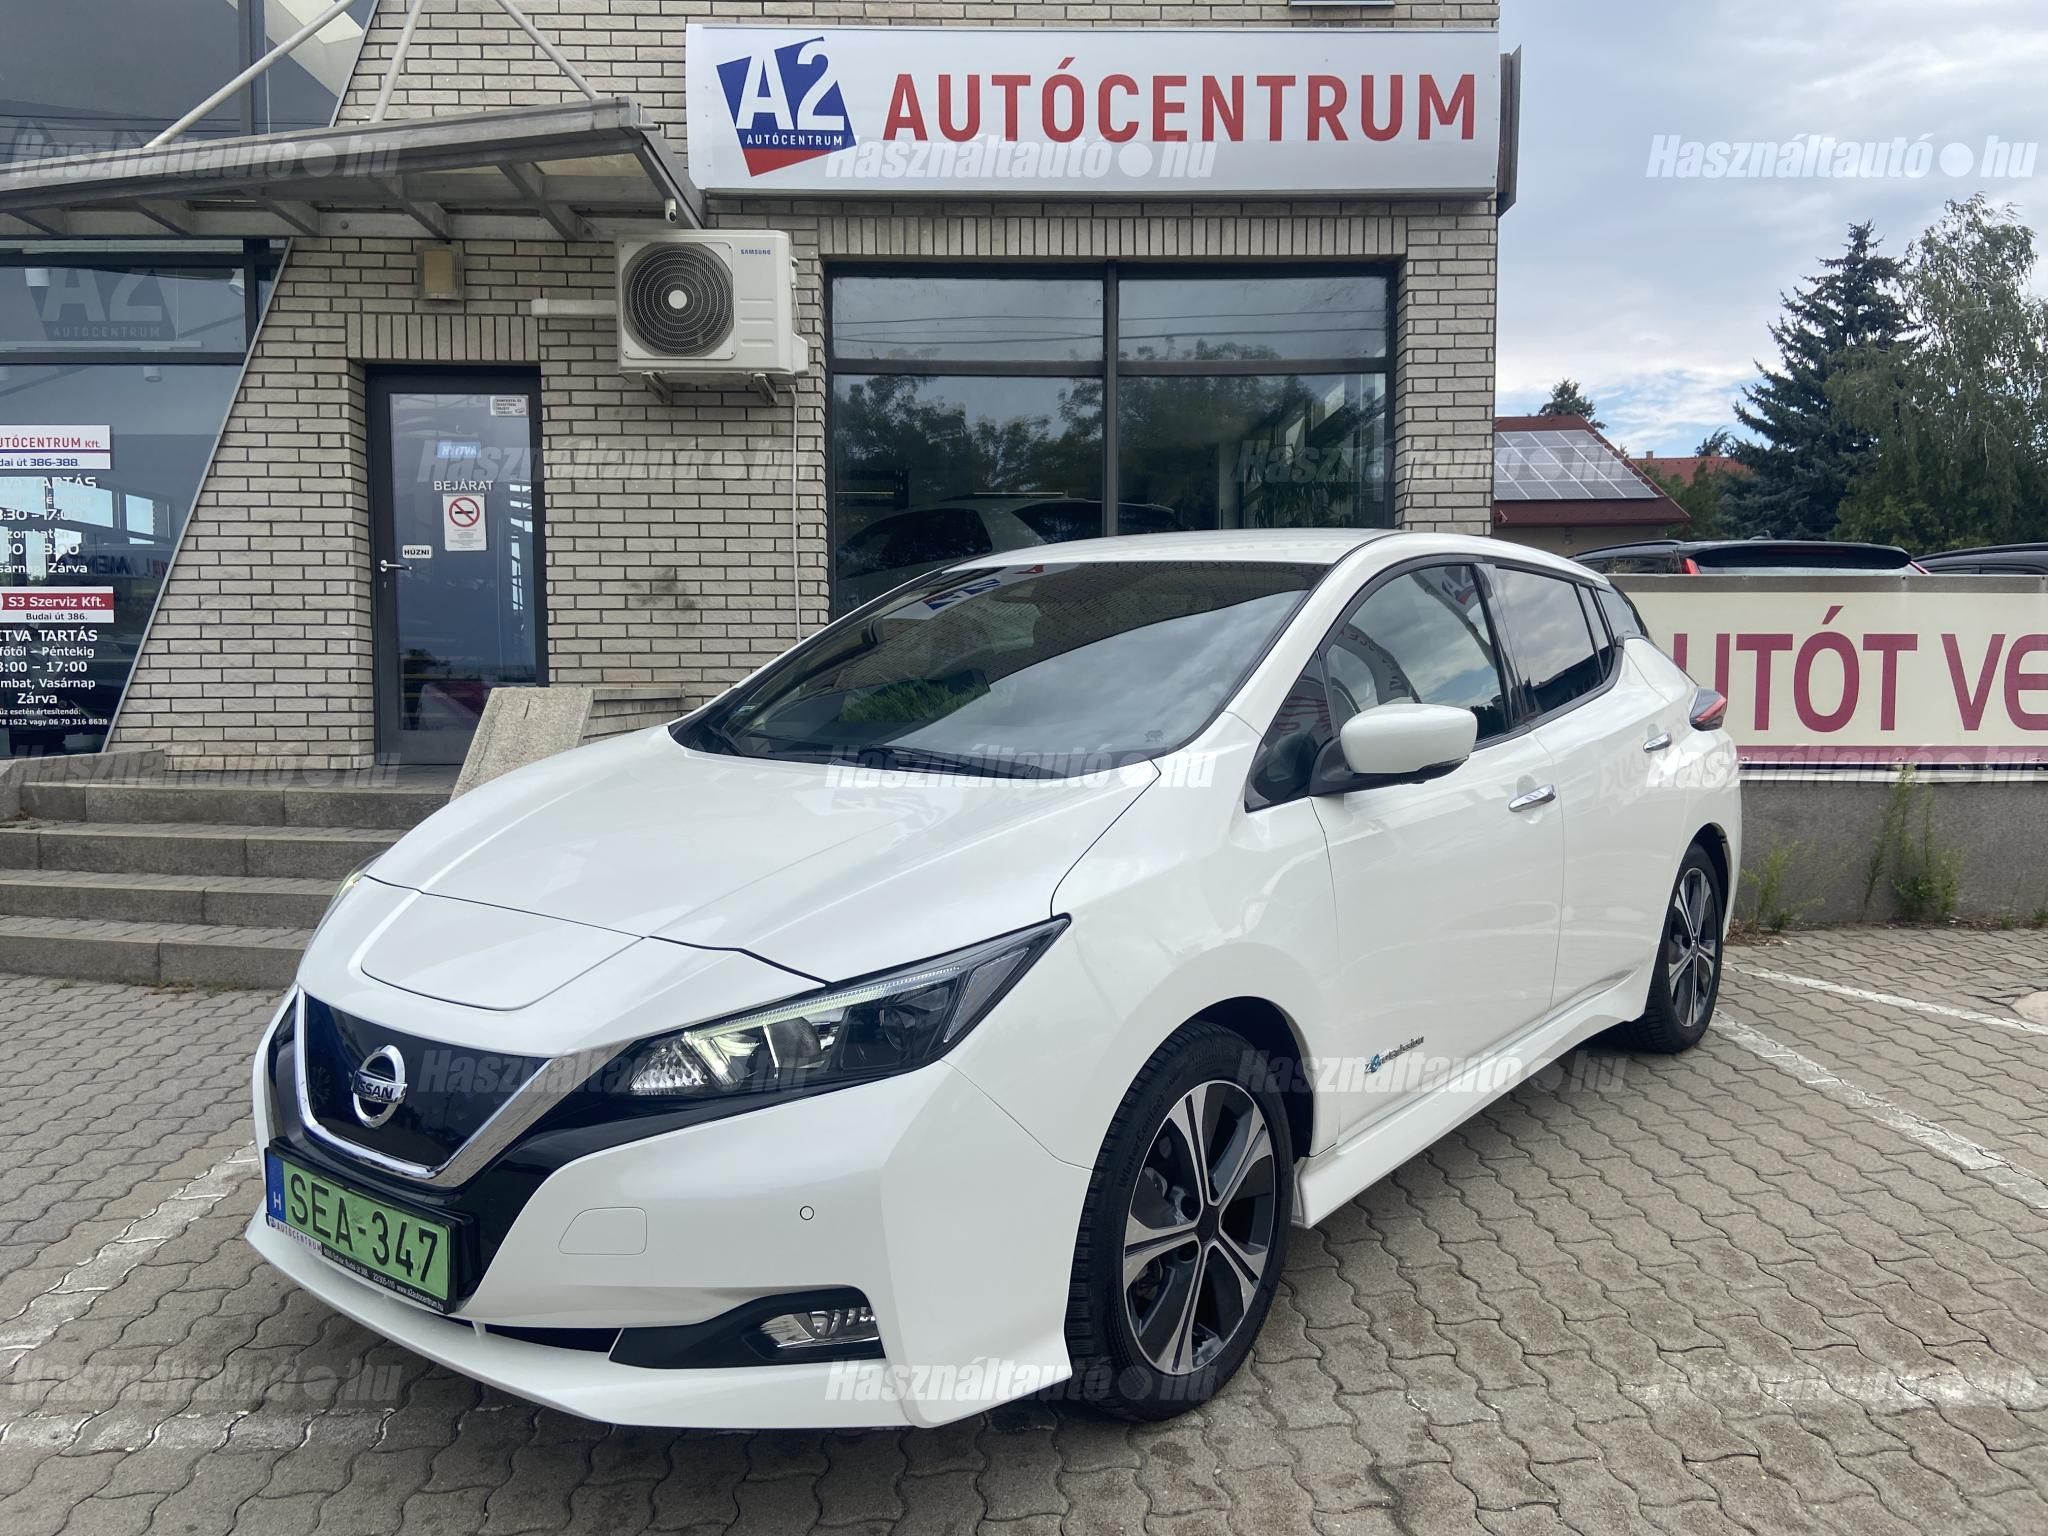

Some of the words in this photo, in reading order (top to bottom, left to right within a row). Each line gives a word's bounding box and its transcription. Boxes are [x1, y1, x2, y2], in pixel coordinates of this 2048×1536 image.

[736, 39, 845, 131] A2
[883, 57, 1476, 143] AUTÓCENTRUM
[746, 132, 844, 147] AUTÓCENTRUM
[17, 458, 27, 467] út
[433, 478, 494, 491] BEJÁRAT
[48, 563, 88, 573] Zárva
[8, 596, 26, 607] S3
[29, 596, 78, 607] Szerviz
[81, 596, 106, 607] Kft.
[25, 612, 52, 621] Budai
[54, 612, 65, 621] út
[67, 613, 88, 621] 386.
[38, 626, 98, 642] TARTÁS
[41, 646, 95, 658] Péntekig
[46, 661, 88, 673] 17:00
[39, 677, 96, 690] Vasárnap
[17, 692, 58, 704] Zárva
[29, 720, 46, 728] vagy
[273, 1192, 282, 1211] H
[290, 1172, 439, 1283] SEA-347
